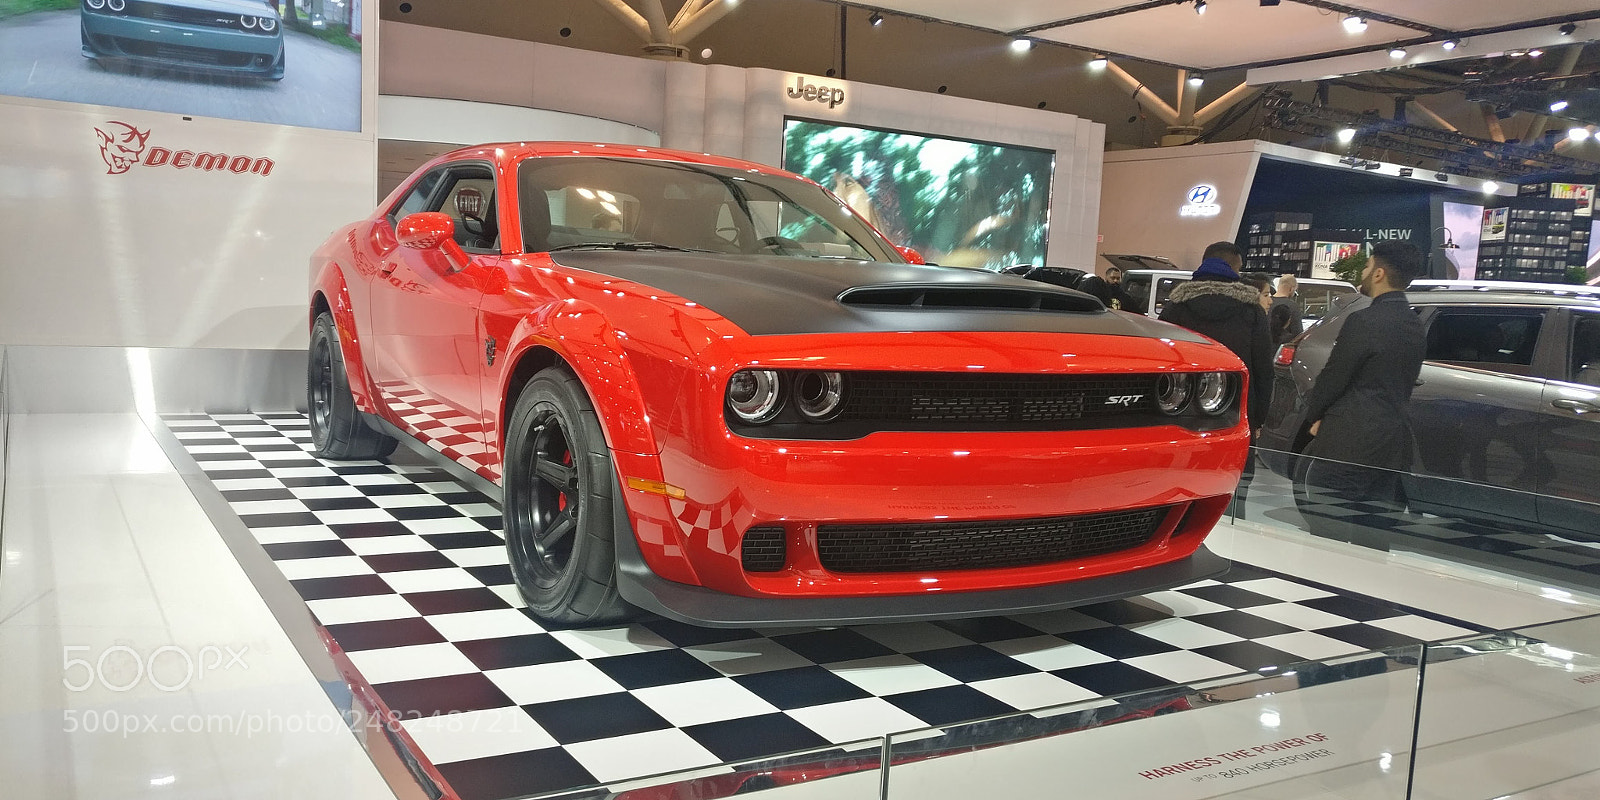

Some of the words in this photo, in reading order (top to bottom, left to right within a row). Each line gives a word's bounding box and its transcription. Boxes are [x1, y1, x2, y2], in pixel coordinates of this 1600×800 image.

[787, 76, 845, 110] Jeep
[143, 146, 276, 177] DEMON
[460, 195, 481, 212] FIAT
[1351, 228, 1412, 240] L-NEW
[1104, 394, 1144, 407] SRT
[1138, 757, 1222, 780] HARNESS
[1216, 749, 1258, 762] THE
[1250, 737, 1312, 755] POWER
[1305, 732, 1329, 742] OF
[1218, 767, 1250, 780] 840
[1245, 748, 1336, 773] HORSEPOWER
